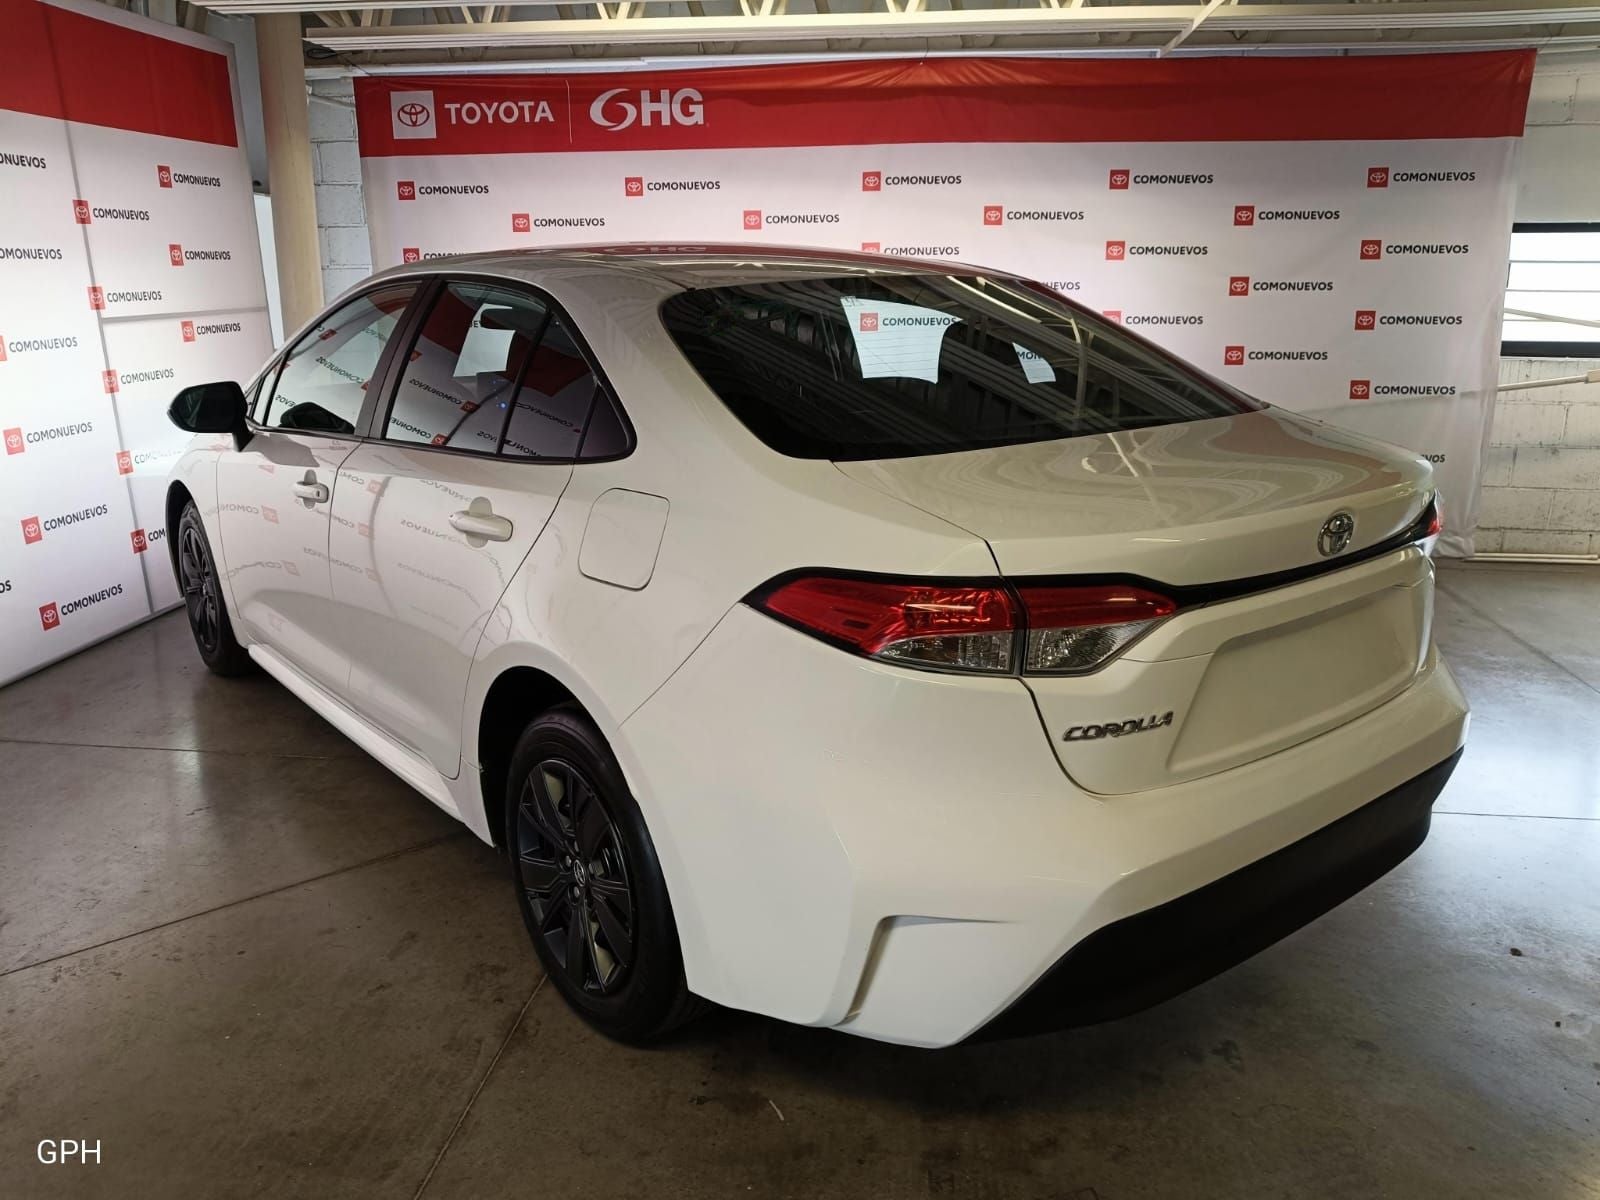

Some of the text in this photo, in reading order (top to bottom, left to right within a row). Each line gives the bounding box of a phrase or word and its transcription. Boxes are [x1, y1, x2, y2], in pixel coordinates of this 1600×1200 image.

[445, 101, 554, 124] TOYOTA
[173, 172, 221, 188] COMONUEVOS
[884, 175, 962, 186] COMONUEVOS
[1132, 174, 1214, 185] COMONUEVOS
[1392, 171, 1476, 182] COMONUEVOS
[418, 184, 490, 195] COMONUEVOS
[646, 180, 721, 192] COMONUEVOS
[92, 207, 150, 221] COMONUEVOS
[765, 214, 840, 225] COMONUEVOS
[1006, 211, 1085, 221] COMONUEVOS
[1257, 210, 1340, 221] COMONUEVOS
[533, 217, 606, 228] COMONUEVOS
[1129, 245, 1209, 256] COMONUEVOS
[1385, 244, 1469, 255] COMONUEVOS
[184, 250, 232, 261] COMONUEVOS
[1252, 281, 1334, 292] COMONUEVOS
[106, 290, 163, 303] COMONUEVOS
[883, 317, 957, 327] COMONUEVOS
[1125, 315, 1204, 325] COMONUEVOS
[1379, 315, 1463, 326] COMONUEVOS
[196, 322, 241, 336] COMONUEVOS
[8, 336, 78, 353] COMONUEVOS
[1247, 351, 1328, 361] COMONUEVOS
[120, 367, 175, 385] COMONUEVOS
[1373, 385, 1456, 396] COMONUEVOS
[26, 421, 93, 444] COMONUEVOS
[43, 503, 108, 532] COMONUEVOS
[60, 583, 123, 616] COMONUEVOS
[1062, 711, 1174, 742] COROLLA
